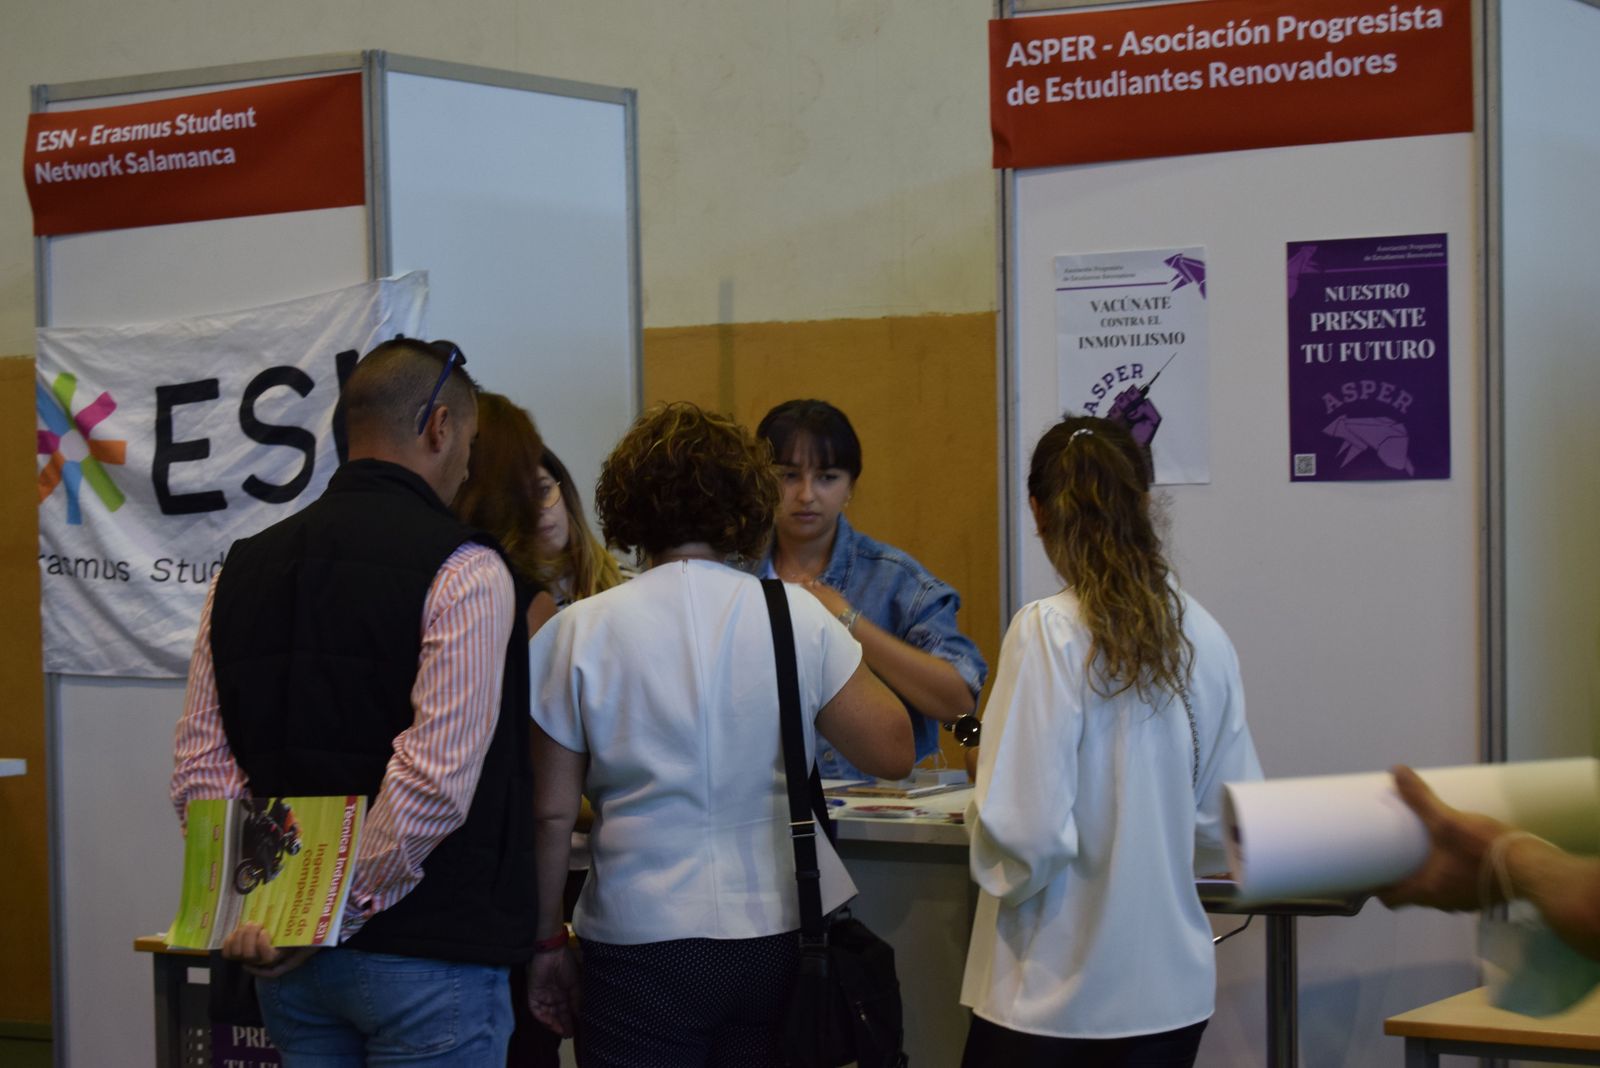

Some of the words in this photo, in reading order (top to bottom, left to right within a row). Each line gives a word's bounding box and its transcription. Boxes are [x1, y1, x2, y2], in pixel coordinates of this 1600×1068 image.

[1005, 35, 1097, 68] ASPER
[1118, 19, 1270, 57] Asociación
[1276, 5, 1443, 43] Progresista
[1006, 79, 1040, 107] de
[1046, 68, 1203, 103] Estudiantes
[1208, 51, 1398, 88] Renovadores
[36, 128, 77, 152] ESN
[89, 120, 172, 146] Erasmus
[174, 107, 257, 136] Student
[34, 154, 123, 184] Network
[124, 147, 236, 174] Salamanca
[1090, 296, 1172, 313] VACÚNATE
[1325, 282, 1410, 302] NUESTRO
[1100, 317, 1145, 328] CONTRA
[1148, 315, 1162, 325] EL
[1310, 307, 1427, 332] PRESENTE
[1078, 331, 1185, 349] INMOVILISMO
[1300, 342, 1333, 364] TU
[1339, 338, 1436, 363] FUTURO
[1083, 363, 1144, 416] ASPER
[1322, 380, 1413, 414] ASPER
[152, 349, 359, 516] ES
[319, 856, 348, 918] Industrial
